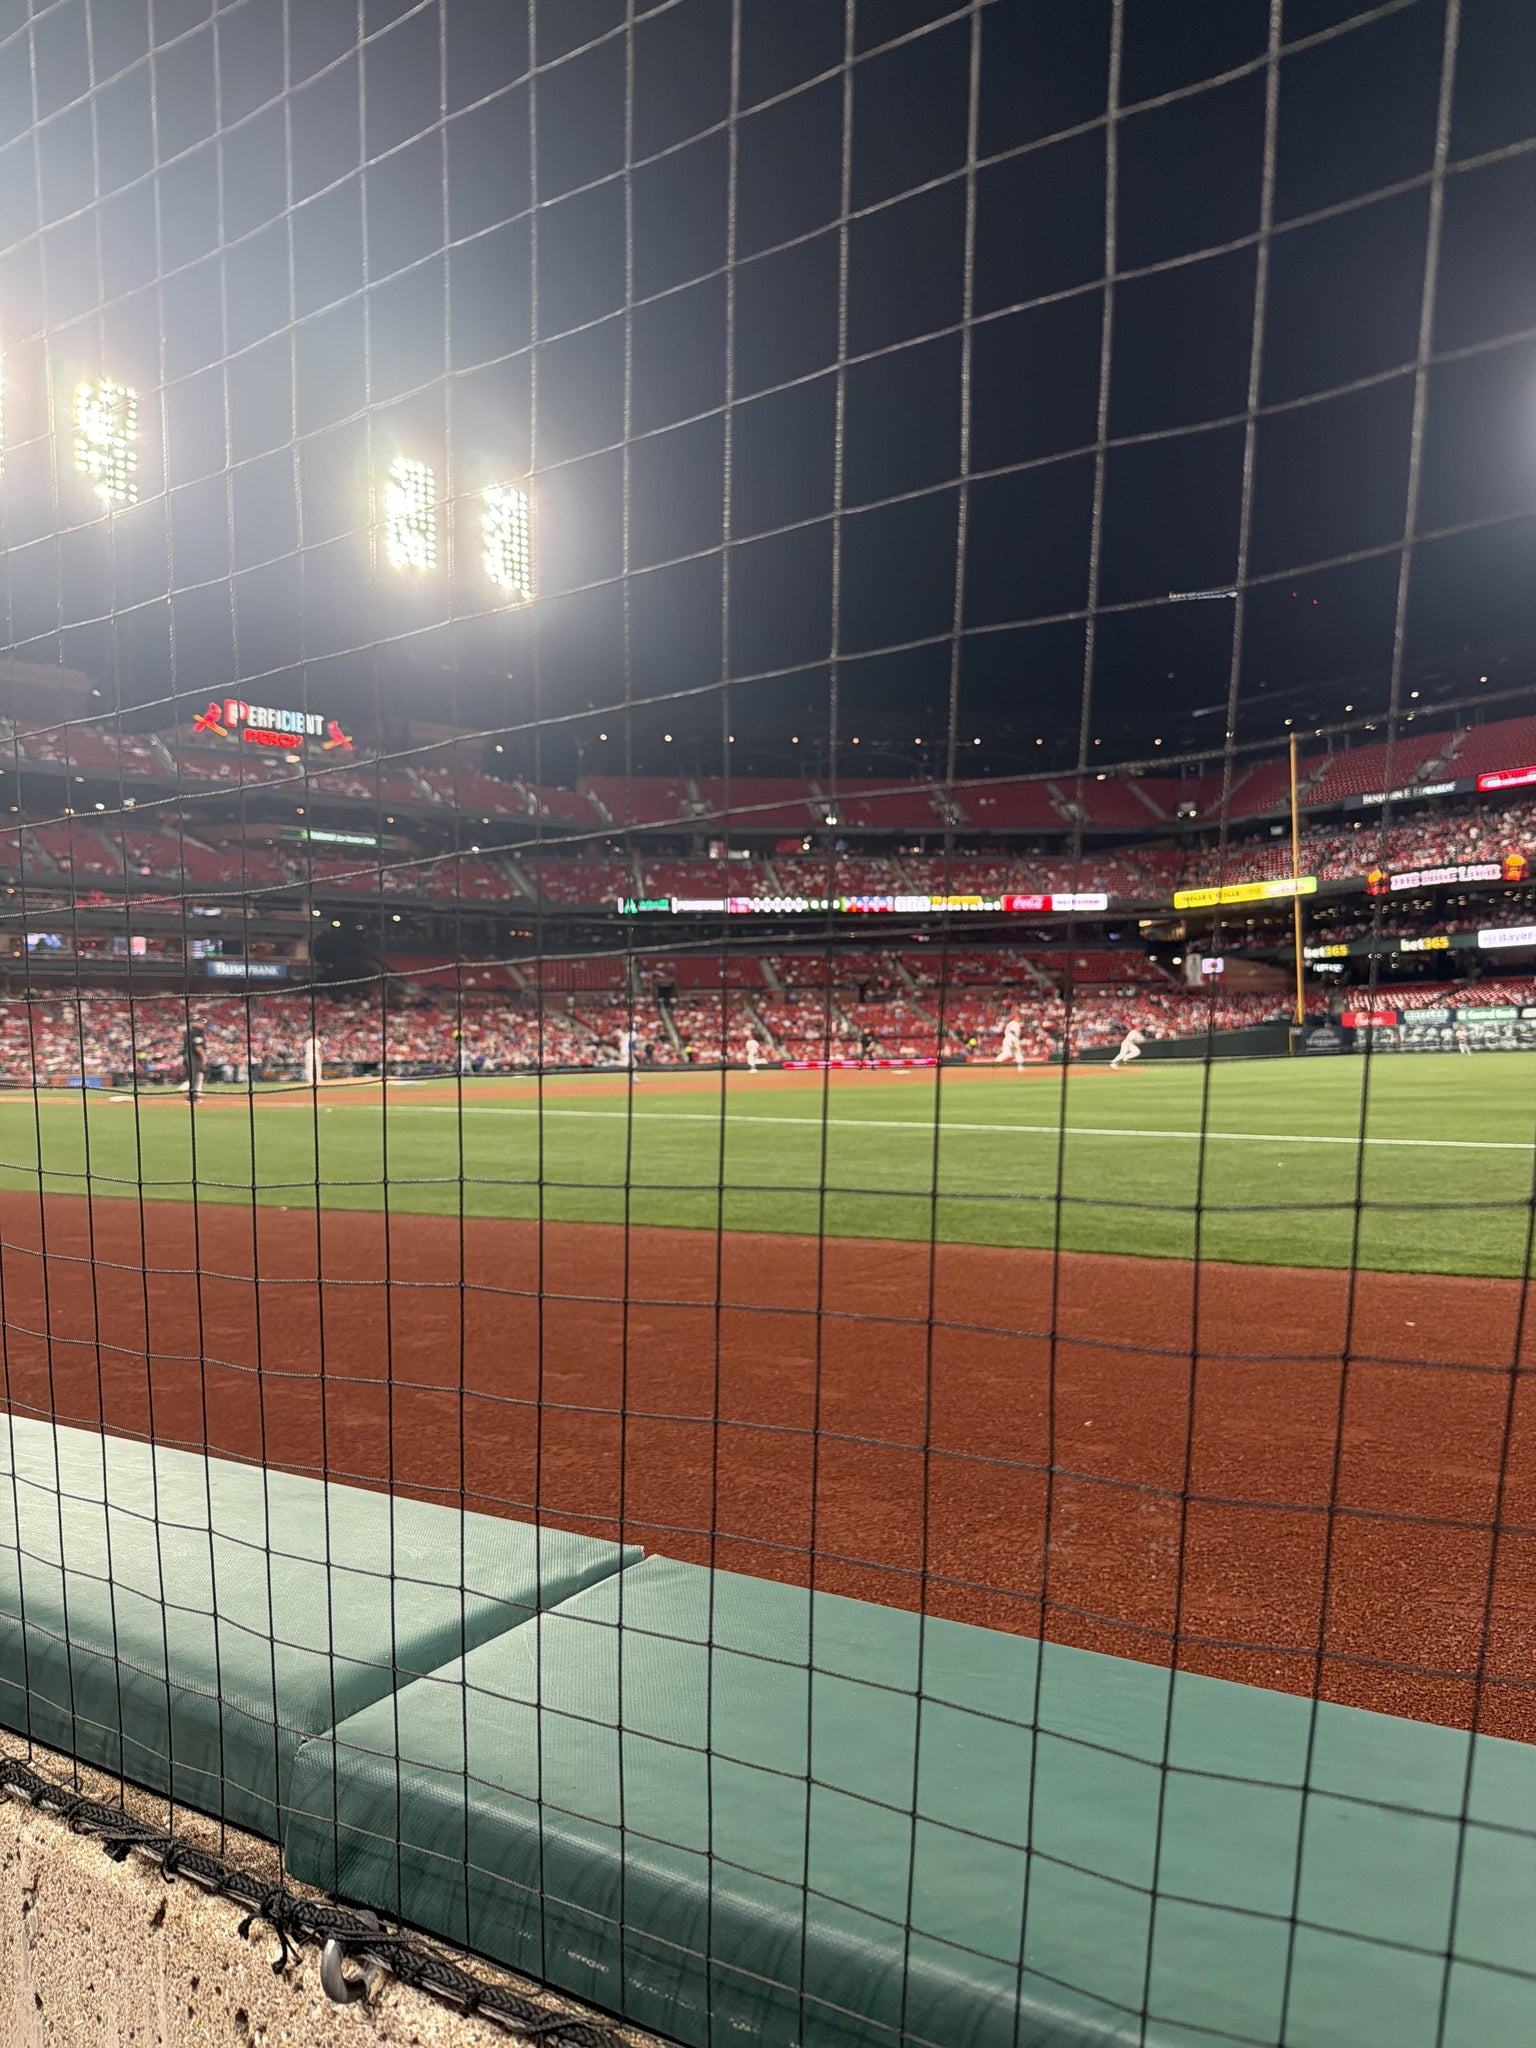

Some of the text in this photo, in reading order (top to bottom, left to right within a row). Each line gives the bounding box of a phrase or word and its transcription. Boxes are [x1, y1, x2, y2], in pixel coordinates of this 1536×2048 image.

[224, 699, 324, 735] PERFICIENT
[1400, 936, 1449, 951] bet365
[1303, 945, 1348, 959] bet365
